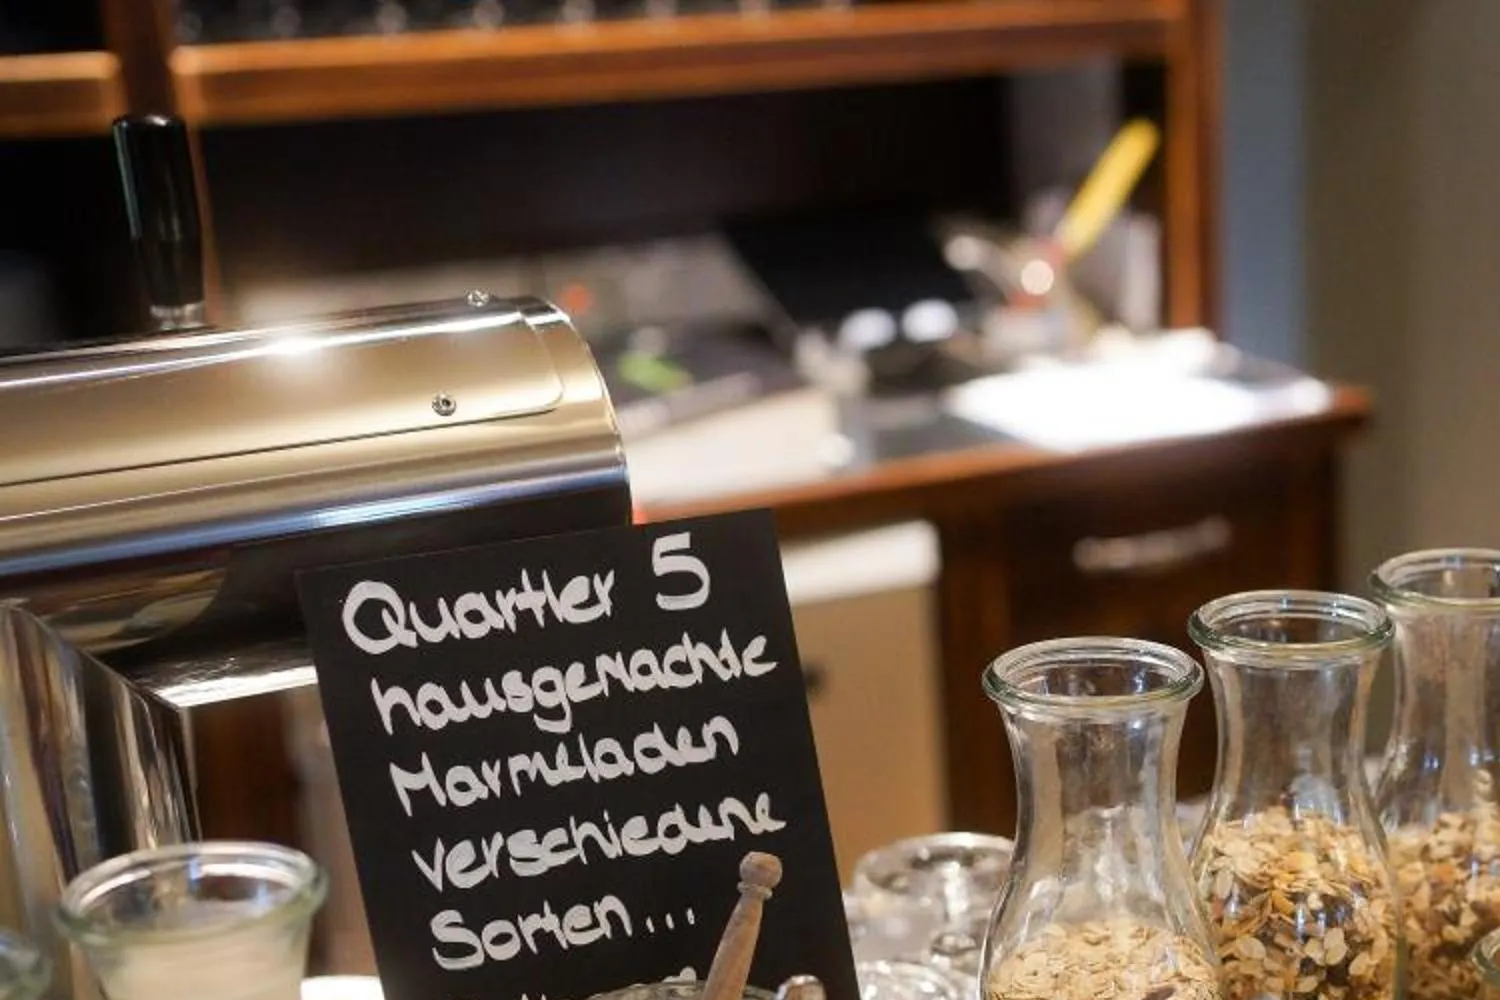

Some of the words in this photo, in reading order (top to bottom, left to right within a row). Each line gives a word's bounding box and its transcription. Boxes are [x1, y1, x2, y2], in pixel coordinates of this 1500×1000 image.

[342, 568, 615, 655] Quartier
[651, 532, 711, 610] 5
[371, 628, 777, 735] hausgemachte
[389, 715, 739, 816] Marmeladen
[412, 792, 787, 893] verschiedene
